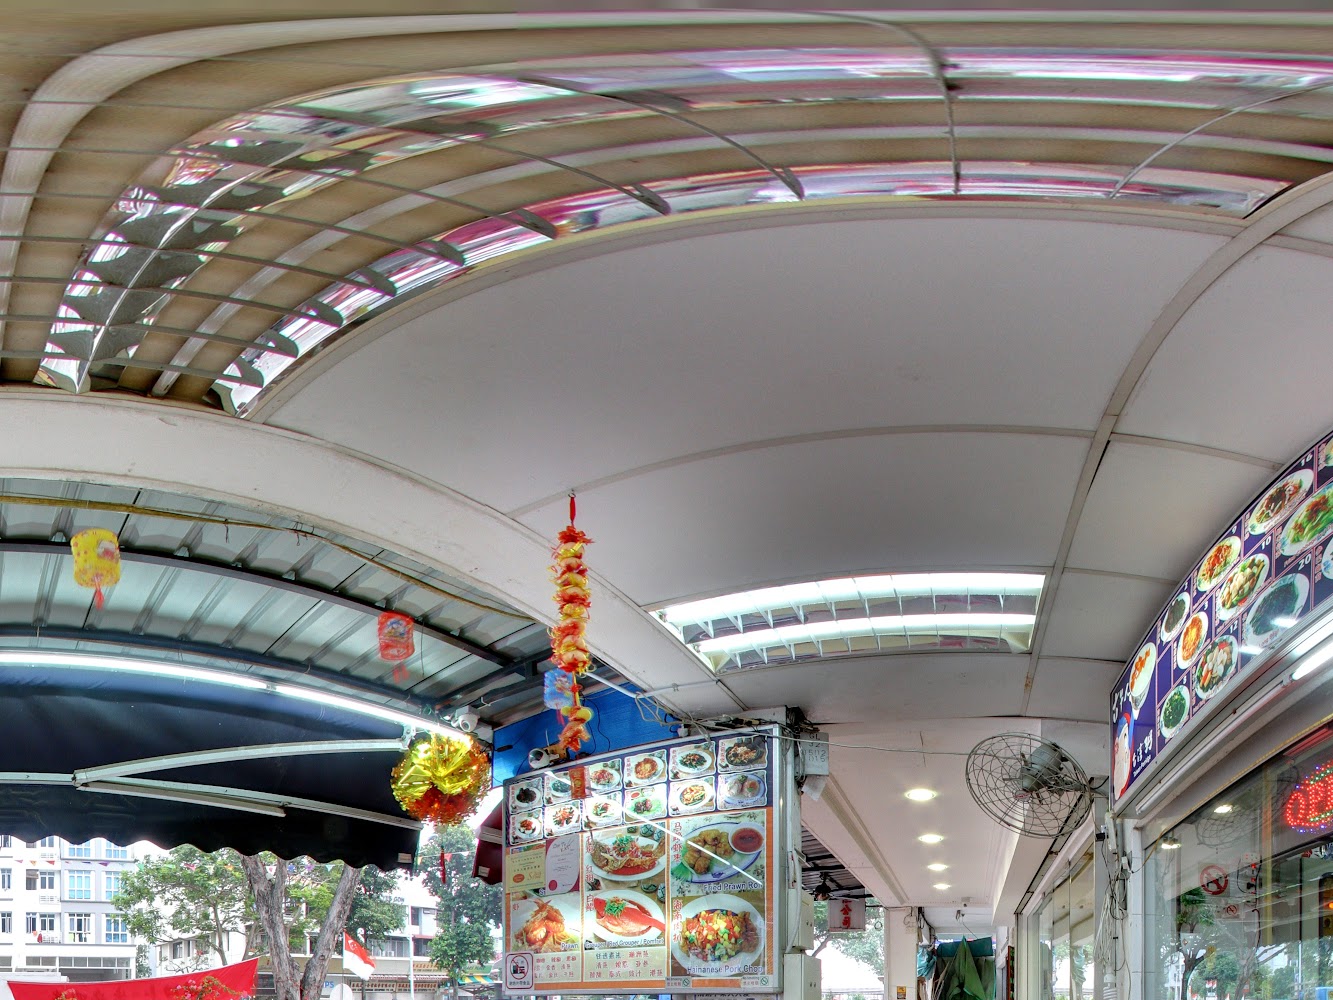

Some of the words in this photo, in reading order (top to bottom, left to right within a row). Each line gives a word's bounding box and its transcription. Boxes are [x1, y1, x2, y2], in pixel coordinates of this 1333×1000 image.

[1300, 454, 1313, 467] 16
[1261, 536, 1272, 550] 10
[1298, 554, 1311, 571] 20
[704, 885, 720, 893] Fried
[723, 883, 746, 891] Prawn
[619, 939, 639, 947] Grouper
[643, 938, 665, 947] Pomfret
[687, 965, 723, 975] Hainanese
[724, 964, 742, 973] Pork
[744, 964, 764, 975] Chop
